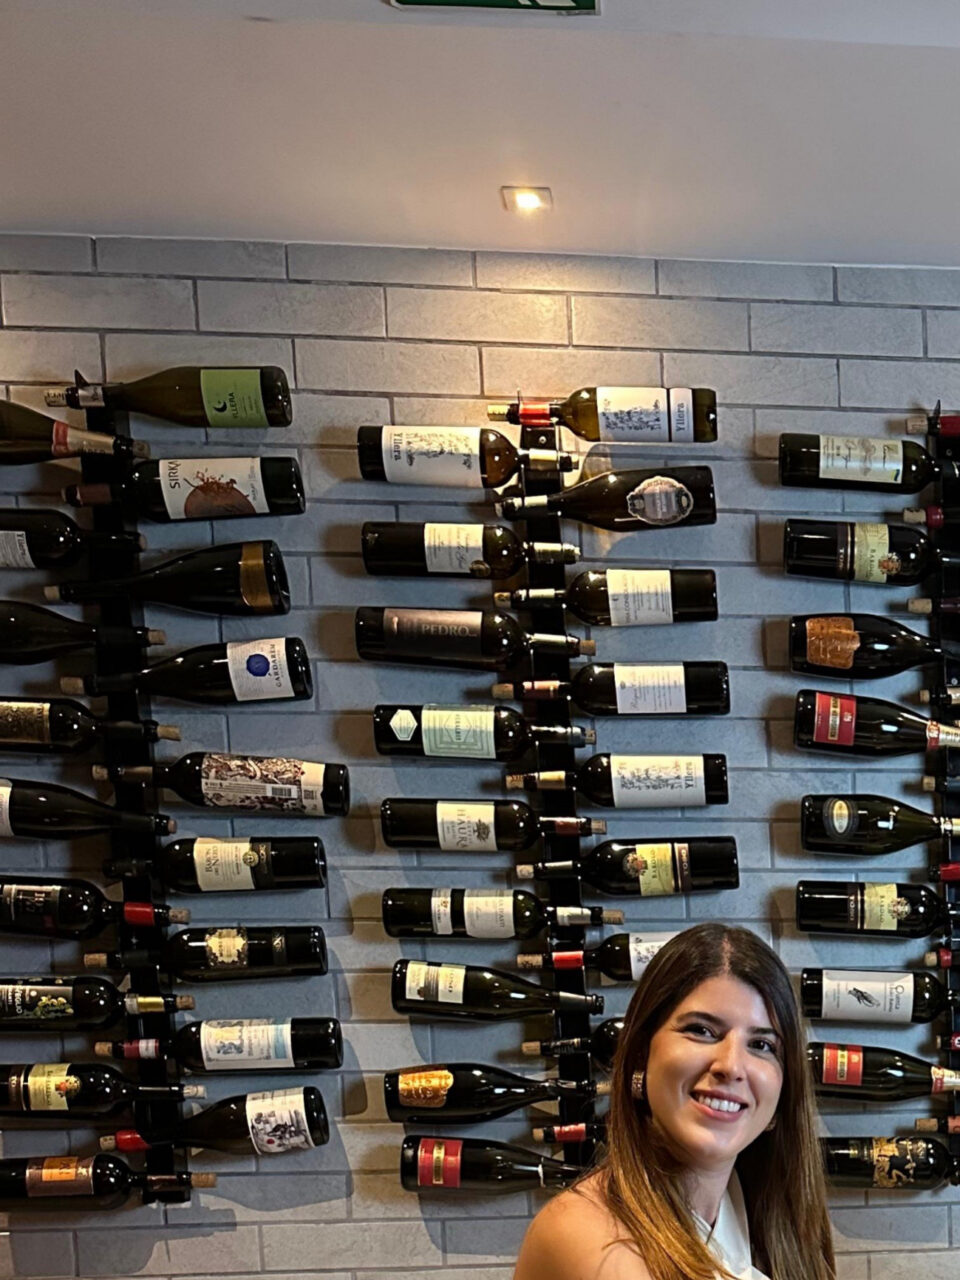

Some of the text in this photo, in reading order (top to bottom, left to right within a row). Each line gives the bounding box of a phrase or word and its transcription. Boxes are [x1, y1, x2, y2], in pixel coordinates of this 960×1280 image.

[675, 403, 685, 431] Yllera
[393, 432, 404, 461] Yllera
[421, 623, 470, 639] PEDRO
[683, 761, 694, 789] Yllera
